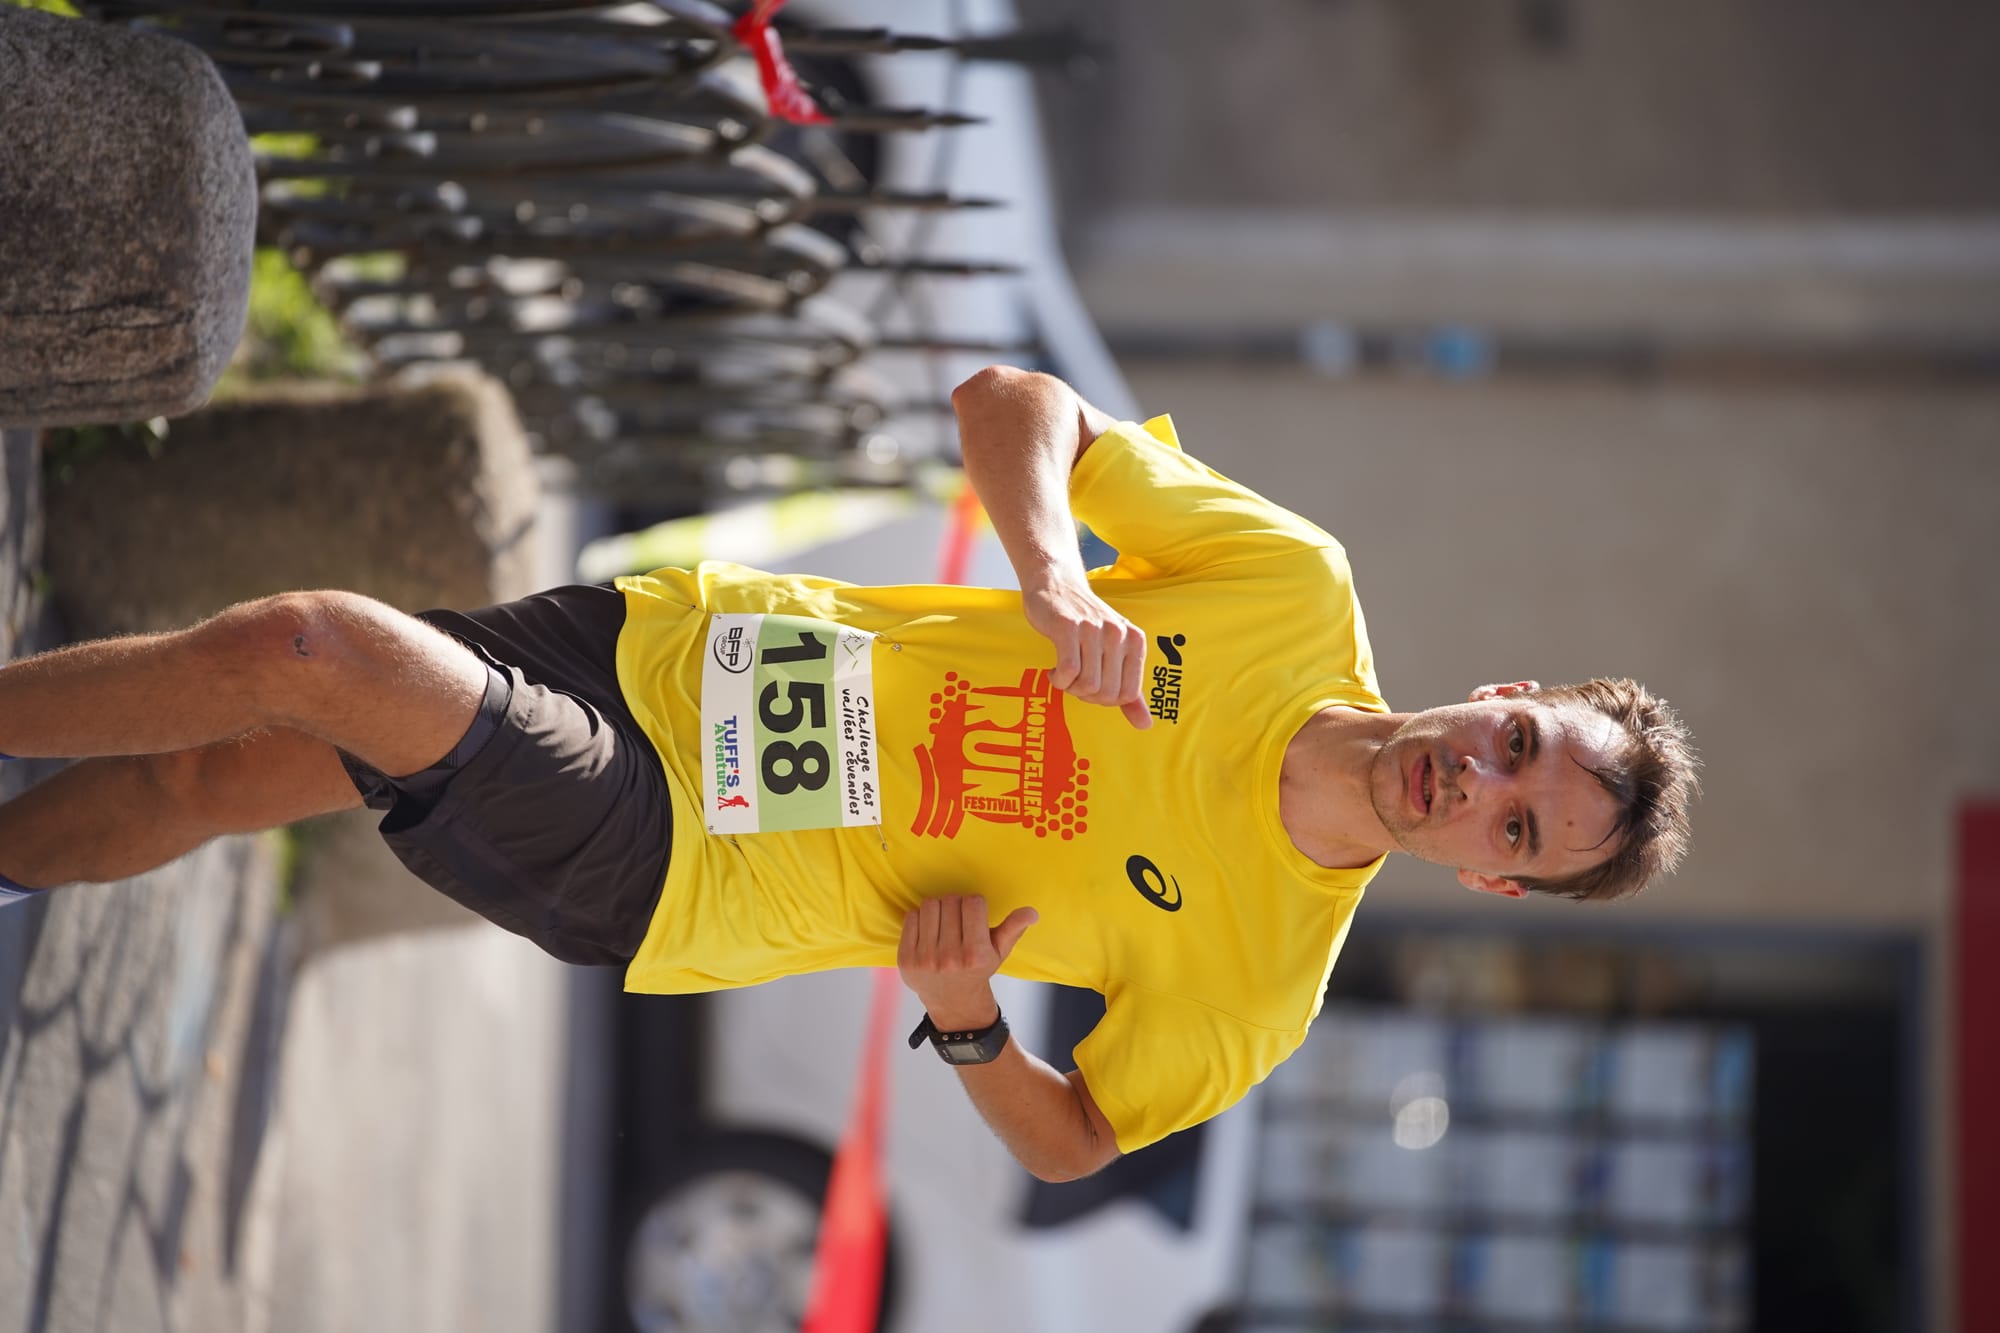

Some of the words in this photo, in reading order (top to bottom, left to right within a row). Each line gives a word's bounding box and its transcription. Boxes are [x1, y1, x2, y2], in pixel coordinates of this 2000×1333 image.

[720, 635, 728, 655] GROUP
[726, 627, 744, 667] BFP
[758, 632, 831, 796] 158
[842, 688, 855, 742] vallées
[1150, 665, 1168, 720] SPORT
[1163, 669, 1183, 722] INTER
[714, 723, 728, 796] Aventure
[723, 715, 740, 788] TUFF'S
[856, 696, 871, 772] Challenge
[961, 692, 1024, 799] RUN
[1023, 696, 1046, 819] MONTPELLIER
[845, 750, 860, 816] cévenoles
[863, 781, 874, 807] des
[963, 796, 1019, 814] FESTIVAL
